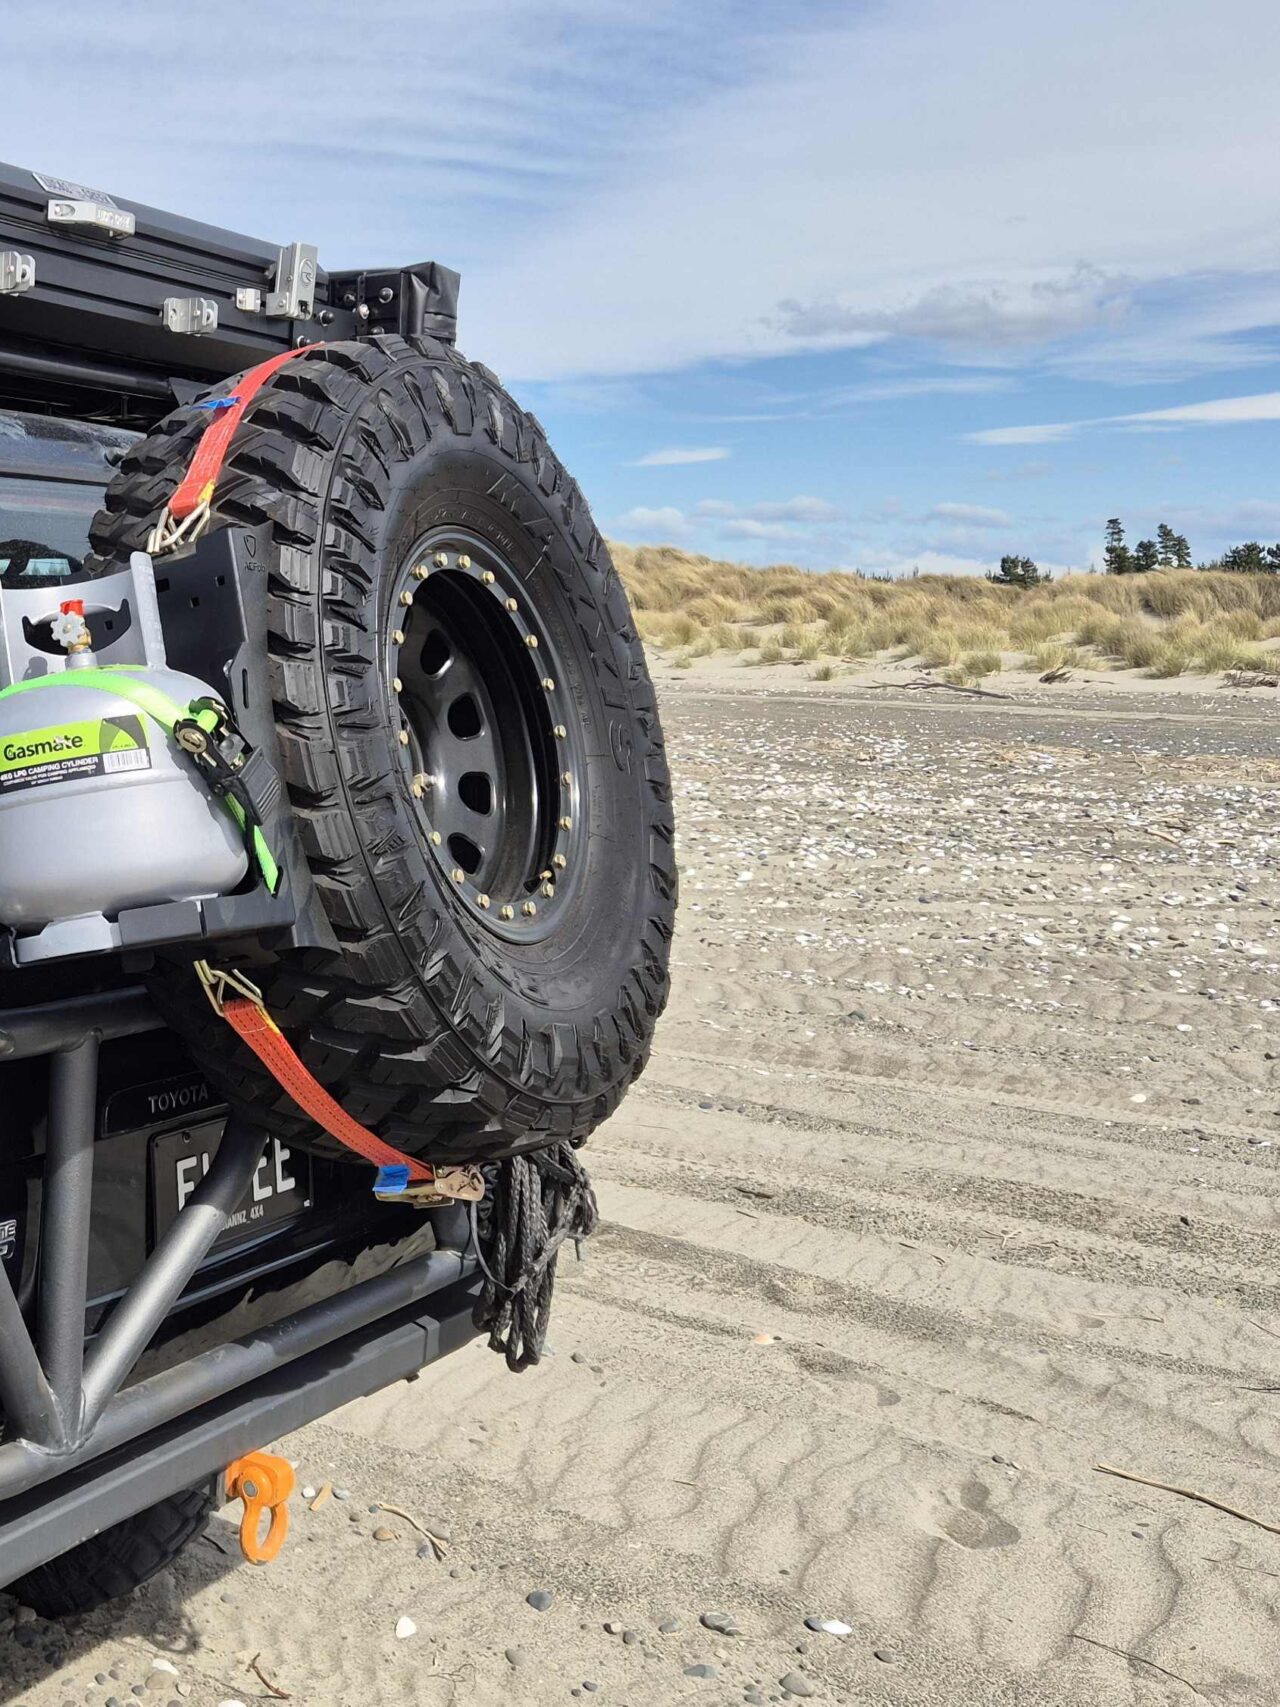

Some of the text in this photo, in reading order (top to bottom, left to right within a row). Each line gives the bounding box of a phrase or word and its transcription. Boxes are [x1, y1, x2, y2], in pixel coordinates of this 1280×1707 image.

[3, 734, 84, 761] Gasmate
[28, 762, 61, 775] CAMPING
[61, 757, 99, 769] CYLINDER
[148, 1082, 209, 1114] TOYOTA
